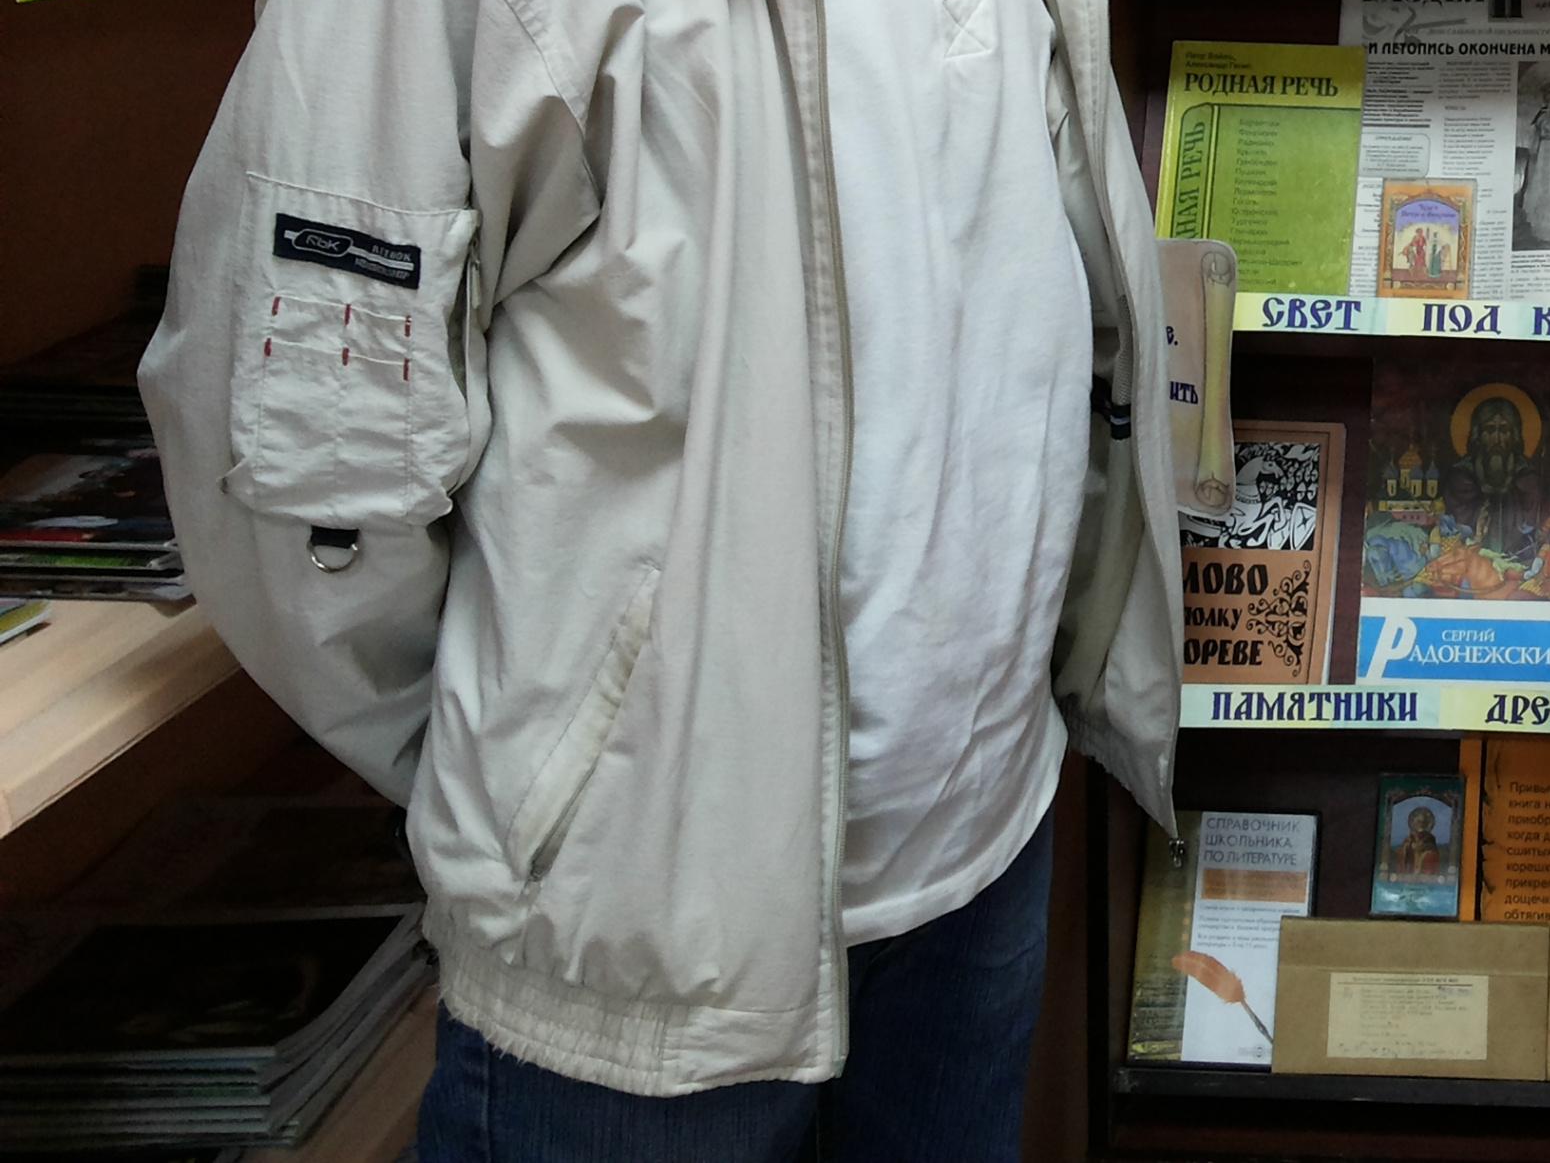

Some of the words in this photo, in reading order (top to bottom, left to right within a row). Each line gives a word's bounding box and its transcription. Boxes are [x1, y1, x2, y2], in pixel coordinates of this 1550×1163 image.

[1381, 42, 1453, 55] ЛЕТОПИСЬ
[1458, 43, 1536, 55] ОКОНЧЕНА
[1183, 72, 1275, 97] РОДНАЯ
[1280, 76, 1339, 97] РЕЧЬ
[1181, 121, 1205, 181] РЕЧЬ
[1175, 188, 1200, 238] НАЯ
[1261, 297, 1362, 331] СВЕТ
[1422, 303, 1501, 336] ПОД
[1169, 381, 1199, 405] ИТЬ
[1183, 561, 1269, 596] ЛОВО
[1441, 628, 1496, 643] СЕРГИЙ
[1184, 638, 1264, 666] ОРЕВЕ
[1211, 690, 1418, 722] ПАМЯТНИКИ
[1508, 800, 1541, 812] книга
[1206, 817, 1302, 833] СПРАВОЧНИК
[1204, 834, 1294, 848] ШКОЛЬНИКА
[1203, 849, 1225, 863] ПО
[1226, 850, 1298, 866] ЛИТЕРАТУРЕ
